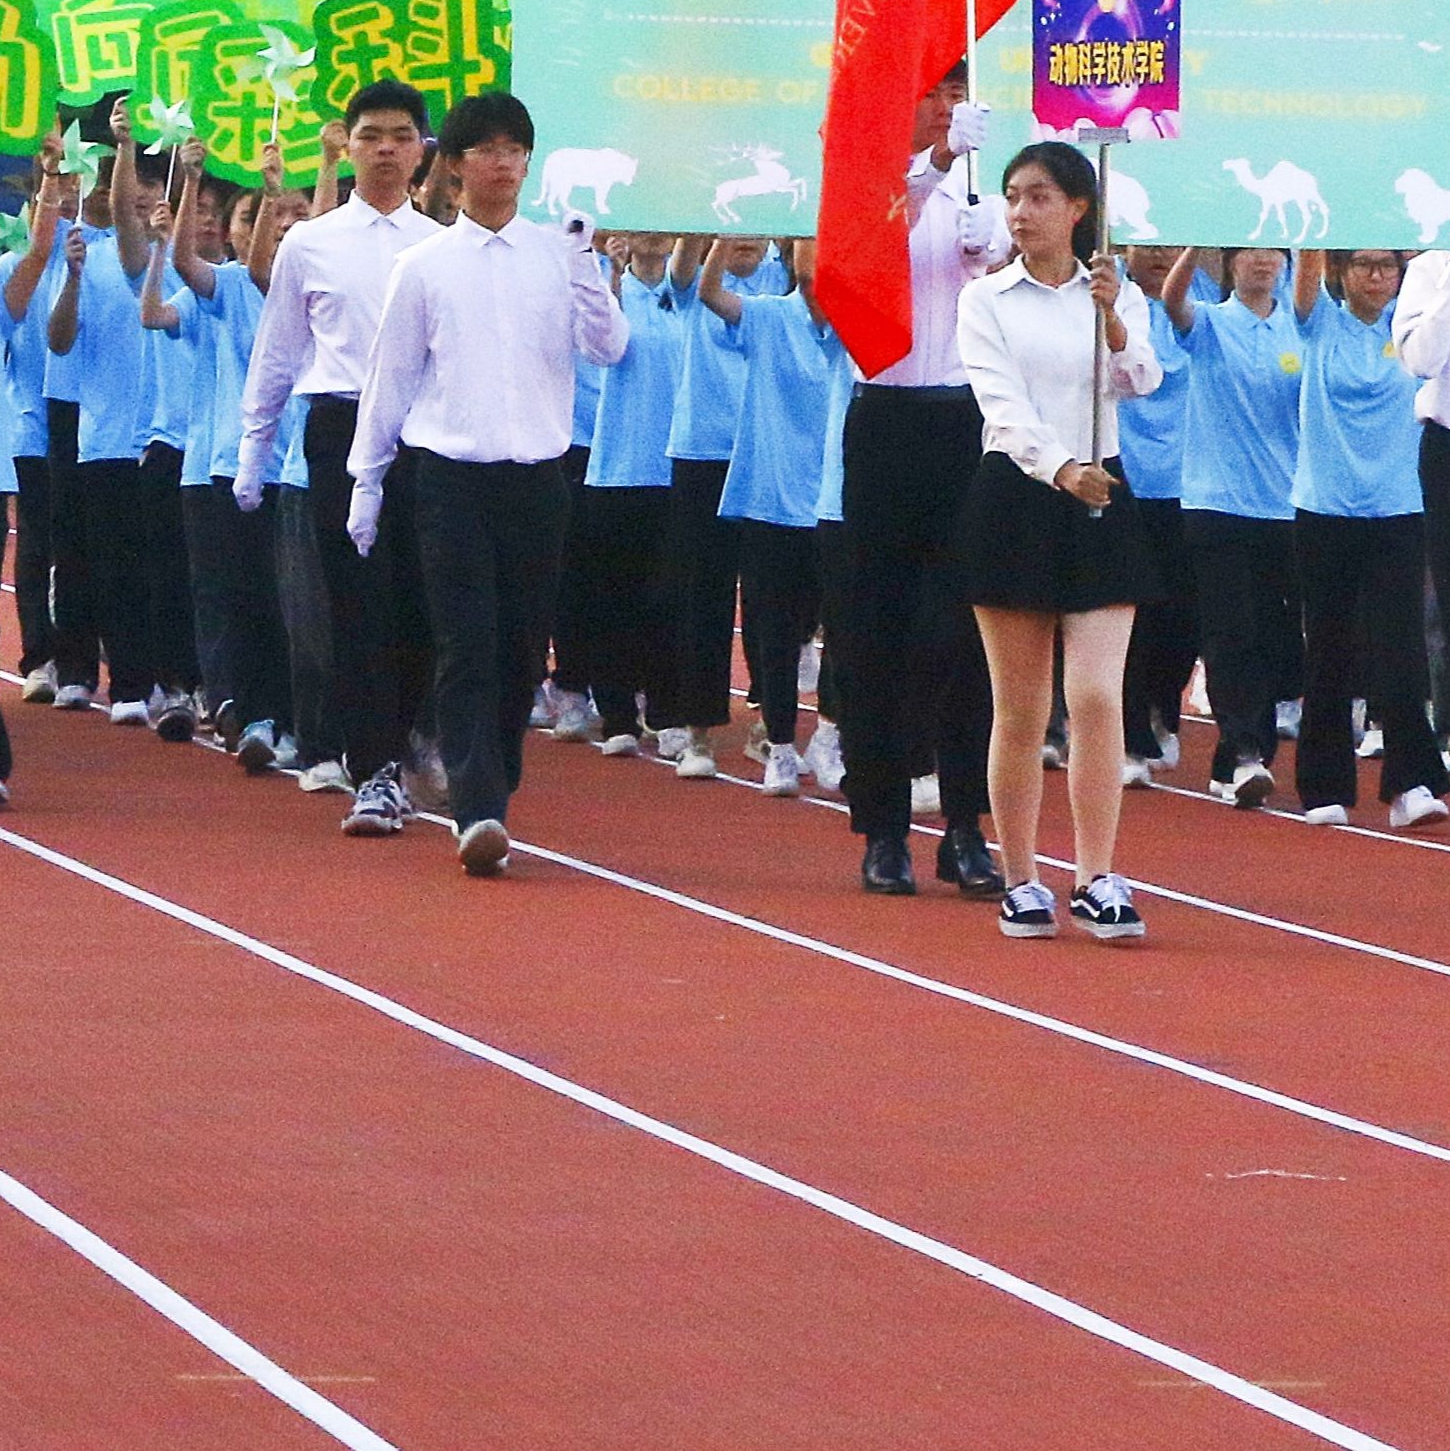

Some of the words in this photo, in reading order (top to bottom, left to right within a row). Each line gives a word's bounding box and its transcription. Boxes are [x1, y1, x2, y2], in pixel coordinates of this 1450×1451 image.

[1049, 39, 1166, 88] 动物科学技术学院
[612, 73, 761, 102] COLLEGE
[1204, 89, 1427, 119] TECHNOLOGY
